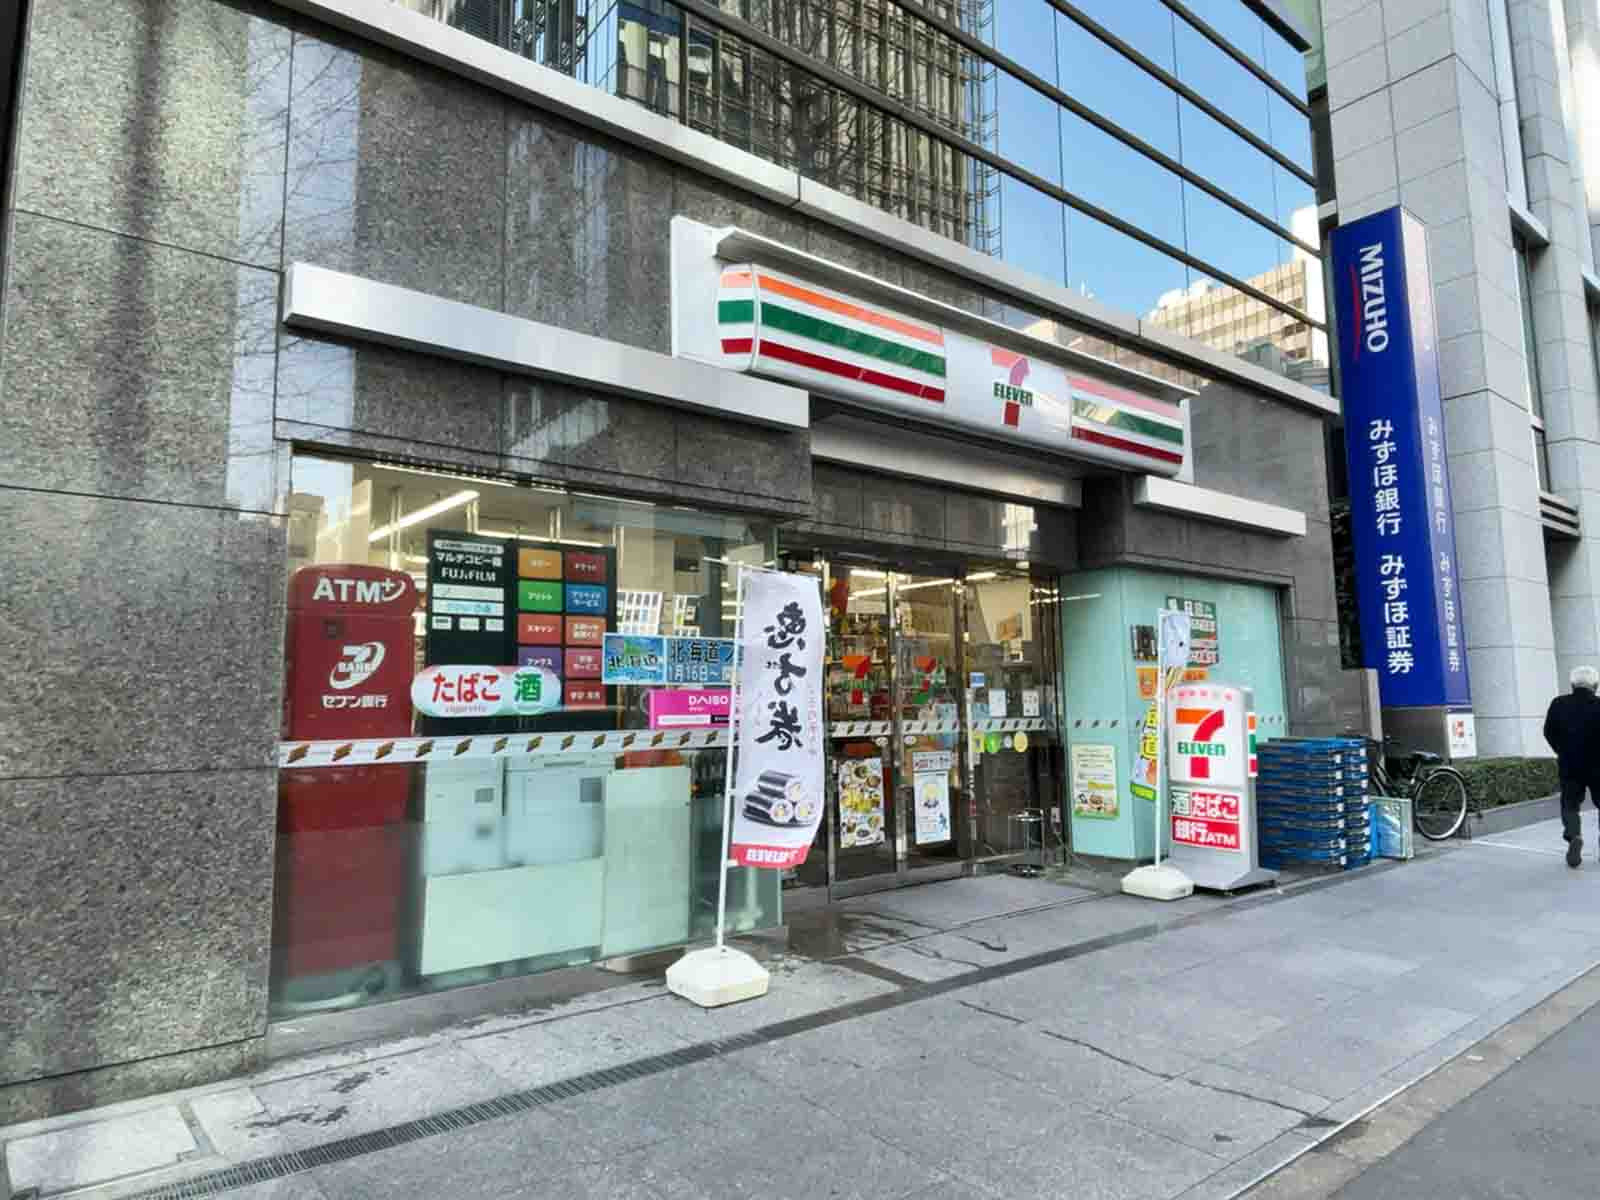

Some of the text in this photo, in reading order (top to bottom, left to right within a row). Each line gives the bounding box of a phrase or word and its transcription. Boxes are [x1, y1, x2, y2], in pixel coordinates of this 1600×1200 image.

[1359, 241, 1389, 353] MIZUHO
[1369, 419, 1414, 674] みずほ銀行 みずほ証券
[441, 567, 496, 582] FUJIFILM
[432, 673, 542, 703] たばこ 酒
[688, 695, 729, 705] DAISO
[322, 695, 388, 709] セブン銀行
[1191, 793, 1239, 820] たばこ
